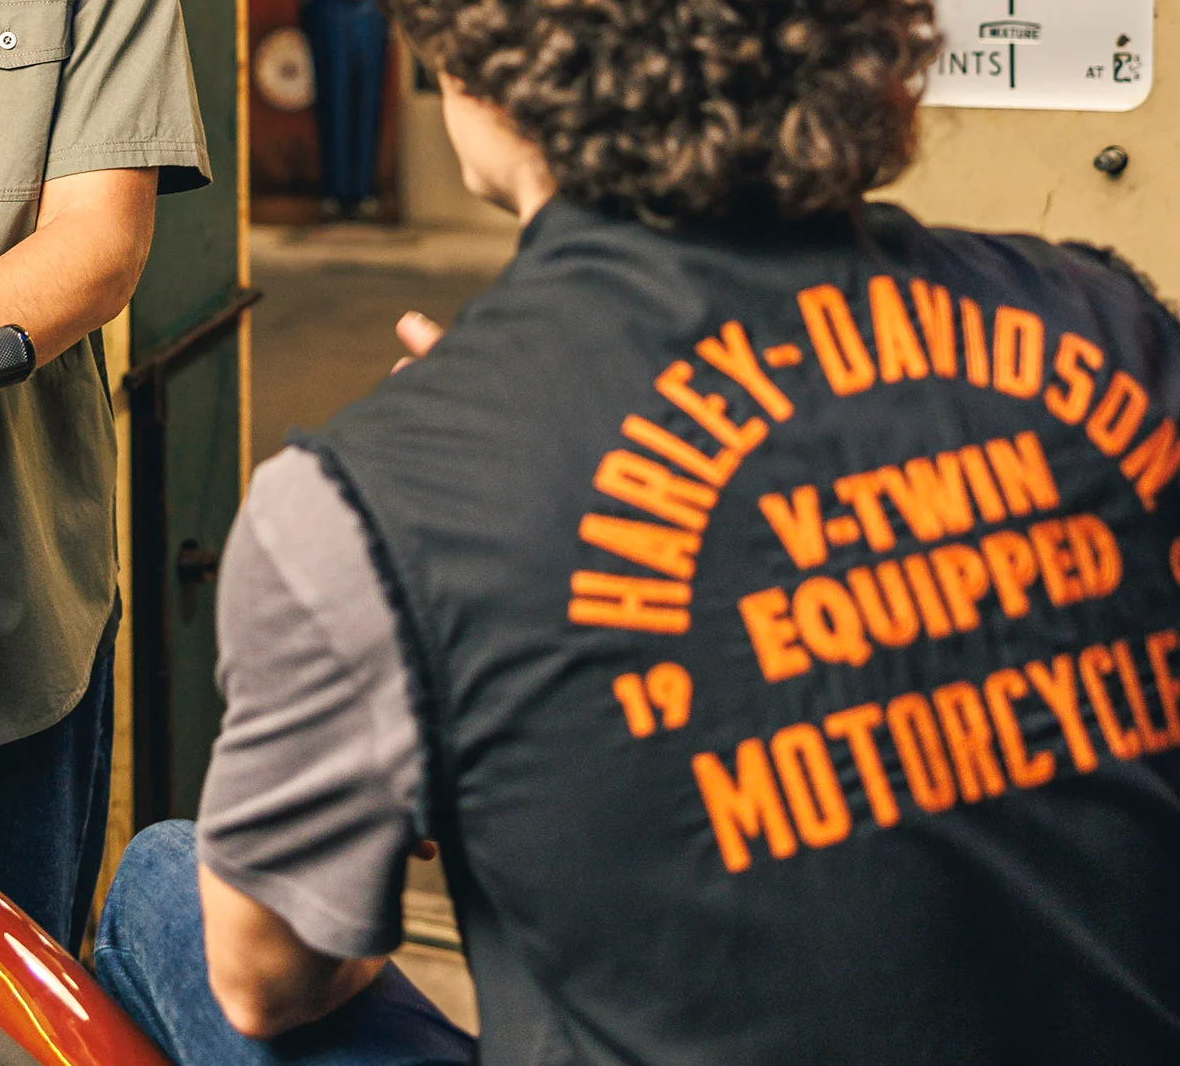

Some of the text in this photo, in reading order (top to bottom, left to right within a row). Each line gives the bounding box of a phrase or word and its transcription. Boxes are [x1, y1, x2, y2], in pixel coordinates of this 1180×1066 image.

[938, 51, 1002, 76] INTS
[567, 275, 1180, 634] HARLEY-DAVIDSON
[757, 430, 1060, 570] V-TWIN
[737, 513, 1123, 683] EQUIPPED
[612, 661, 693, 738] 19
